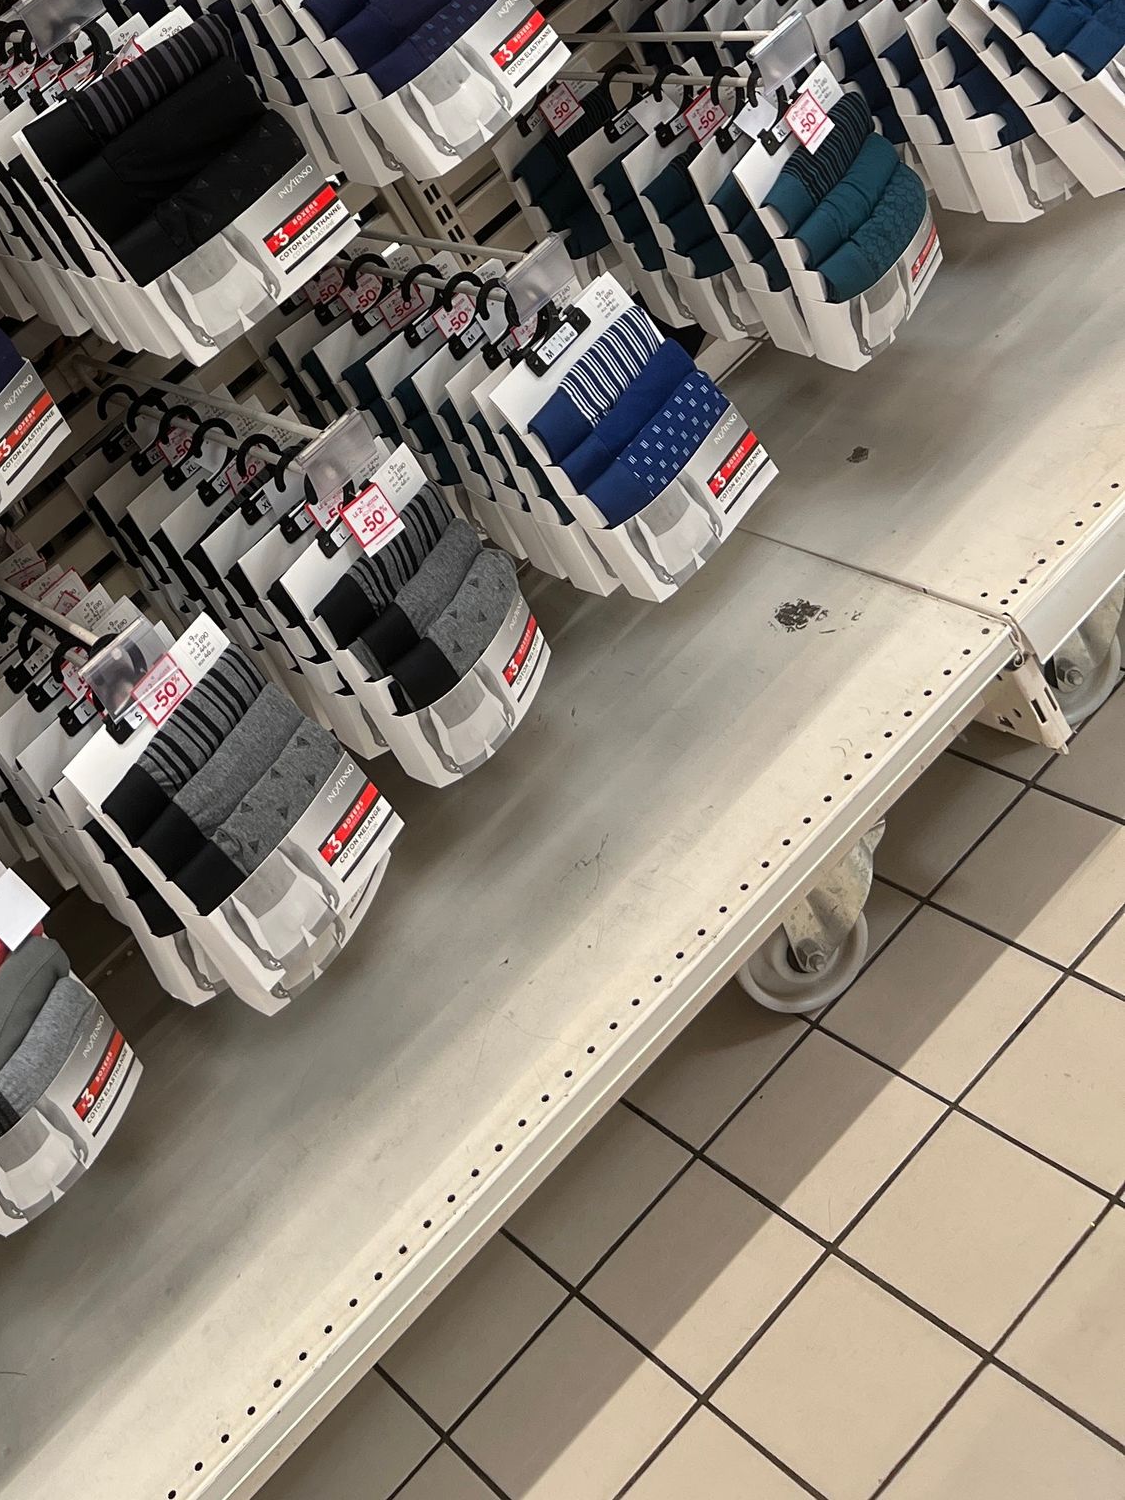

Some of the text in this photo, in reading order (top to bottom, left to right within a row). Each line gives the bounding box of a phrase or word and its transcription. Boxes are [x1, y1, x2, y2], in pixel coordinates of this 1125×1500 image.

[277, 201, 342, 262] COTON ELASTHANNE
[337, 839, 360, 864] COTON
